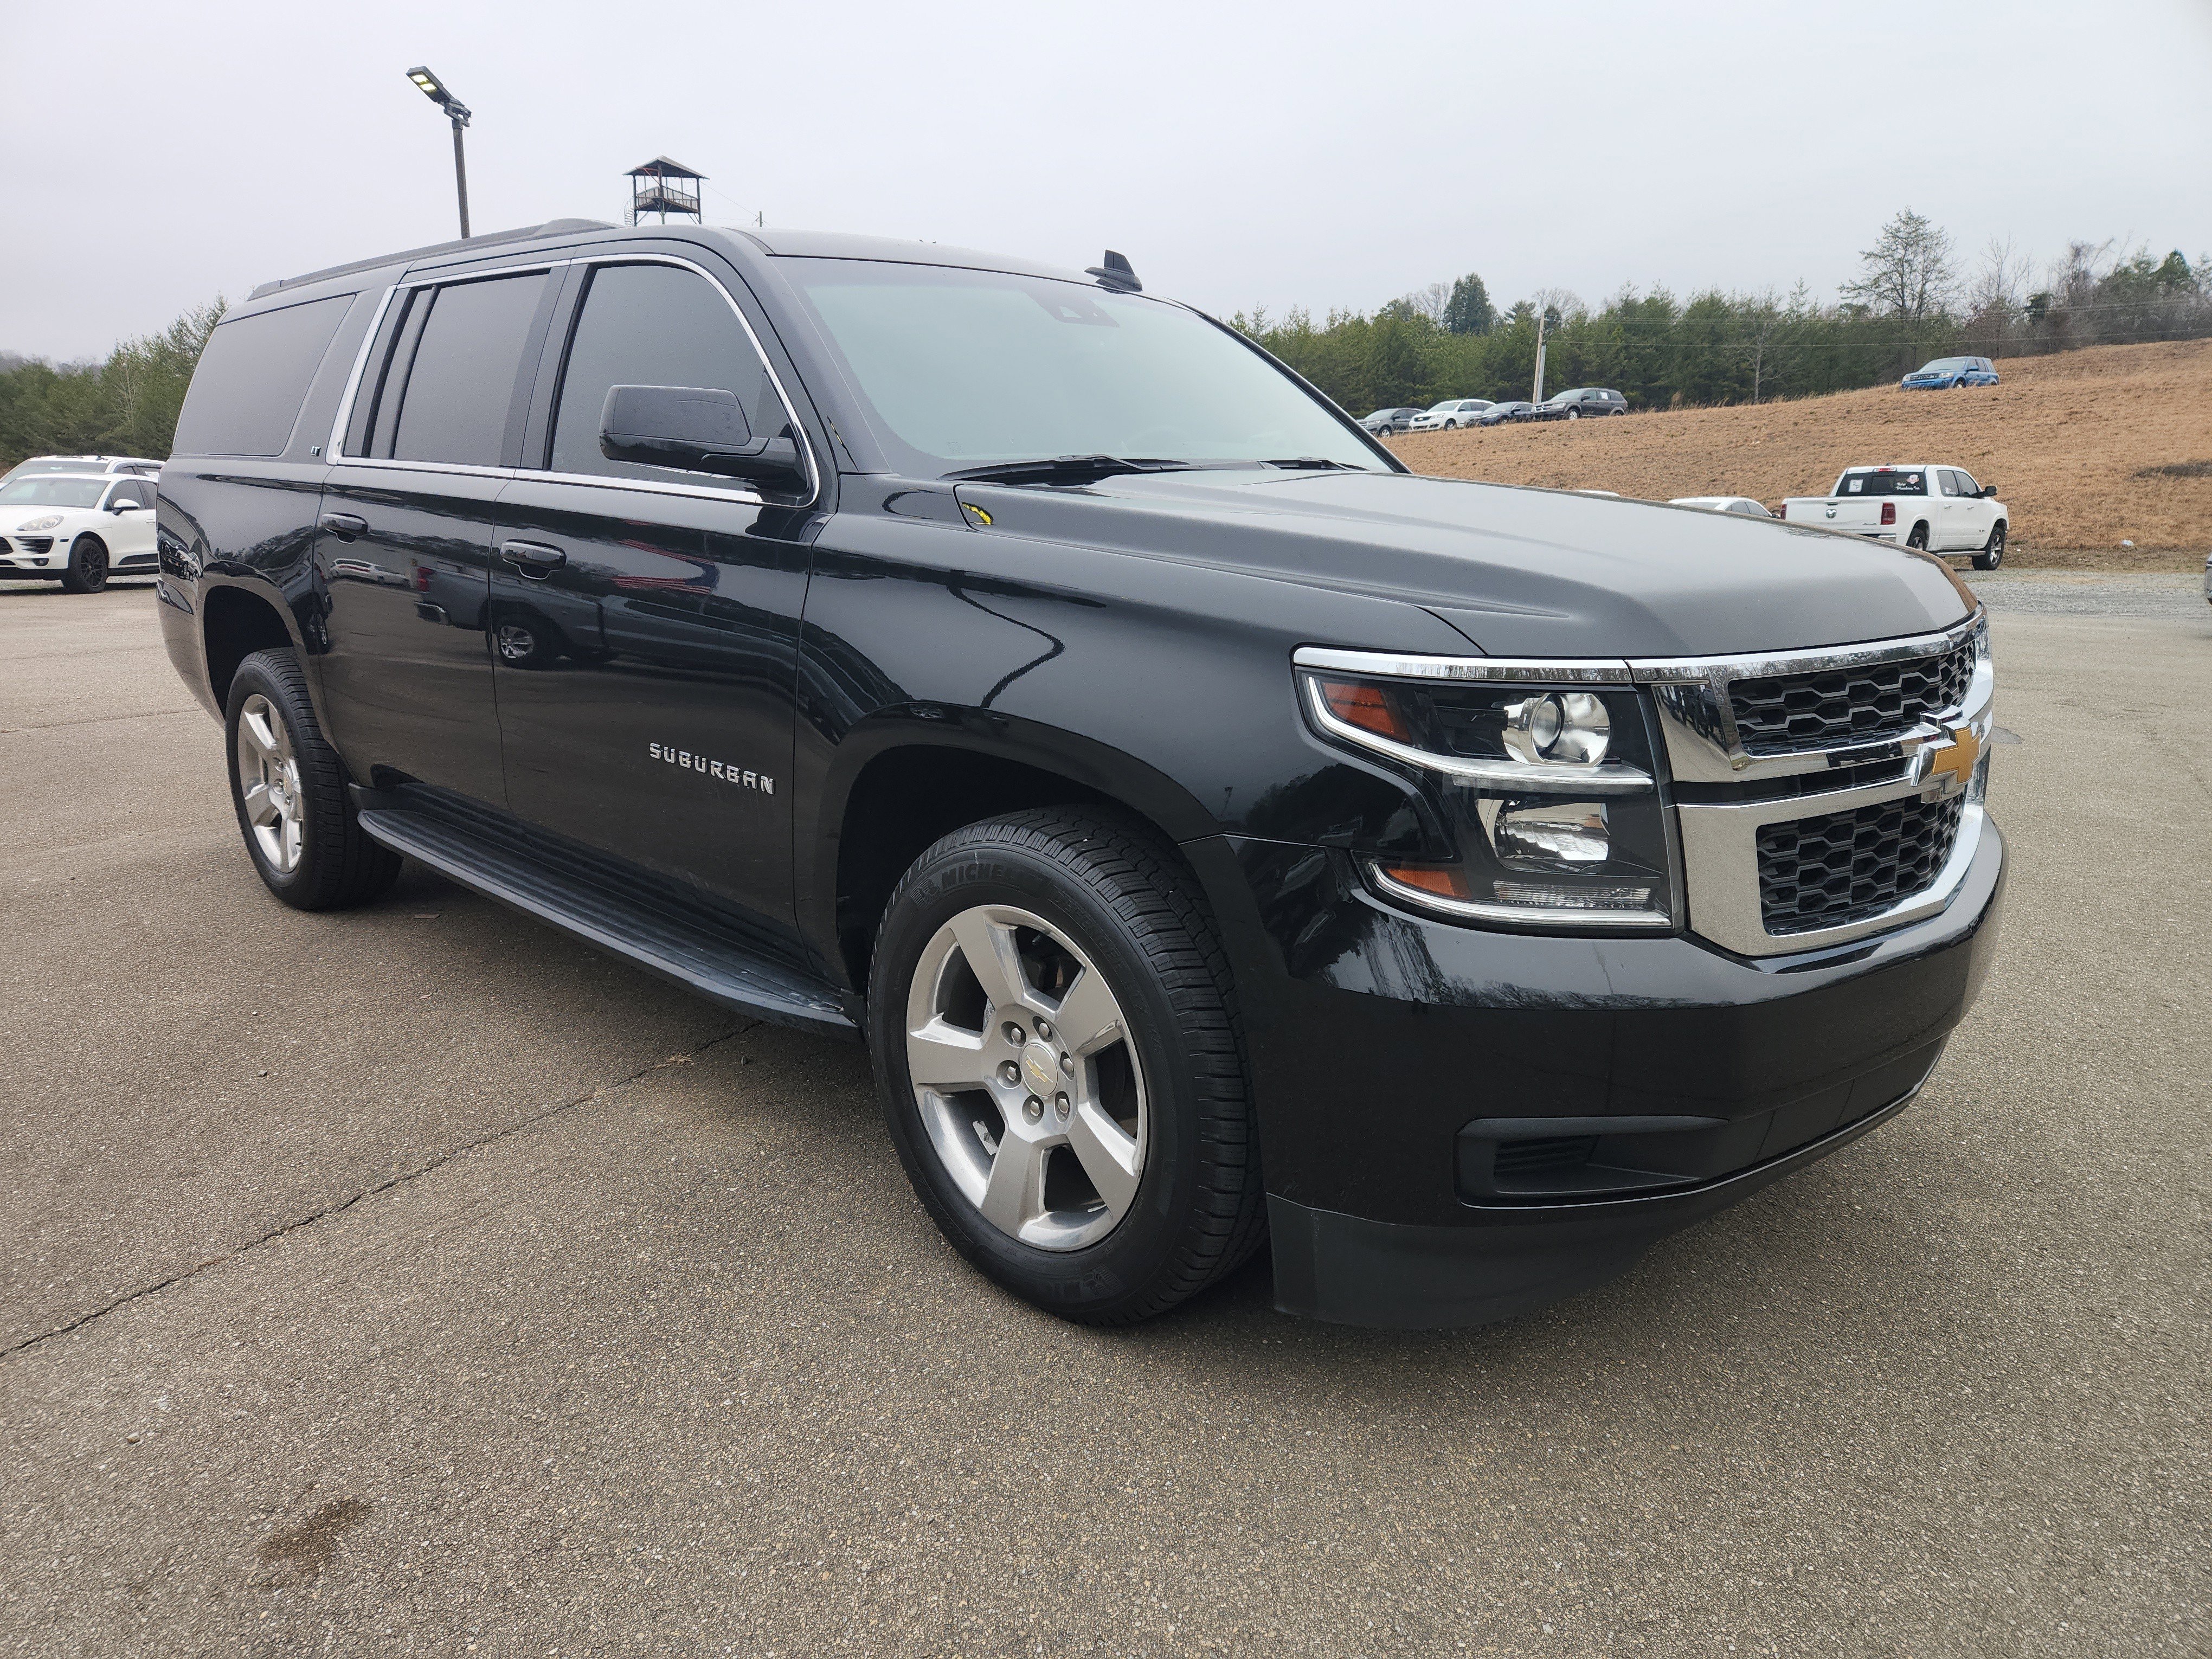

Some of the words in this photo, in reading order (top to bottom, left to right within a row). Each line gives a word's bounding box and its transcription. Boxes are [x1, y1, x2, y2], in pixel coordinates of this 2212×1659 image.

[311, 446, 321, 456] LT
[650, 743, 775, 795] SUBURBAN
[941, 863, 1042, 893] MICHEL
